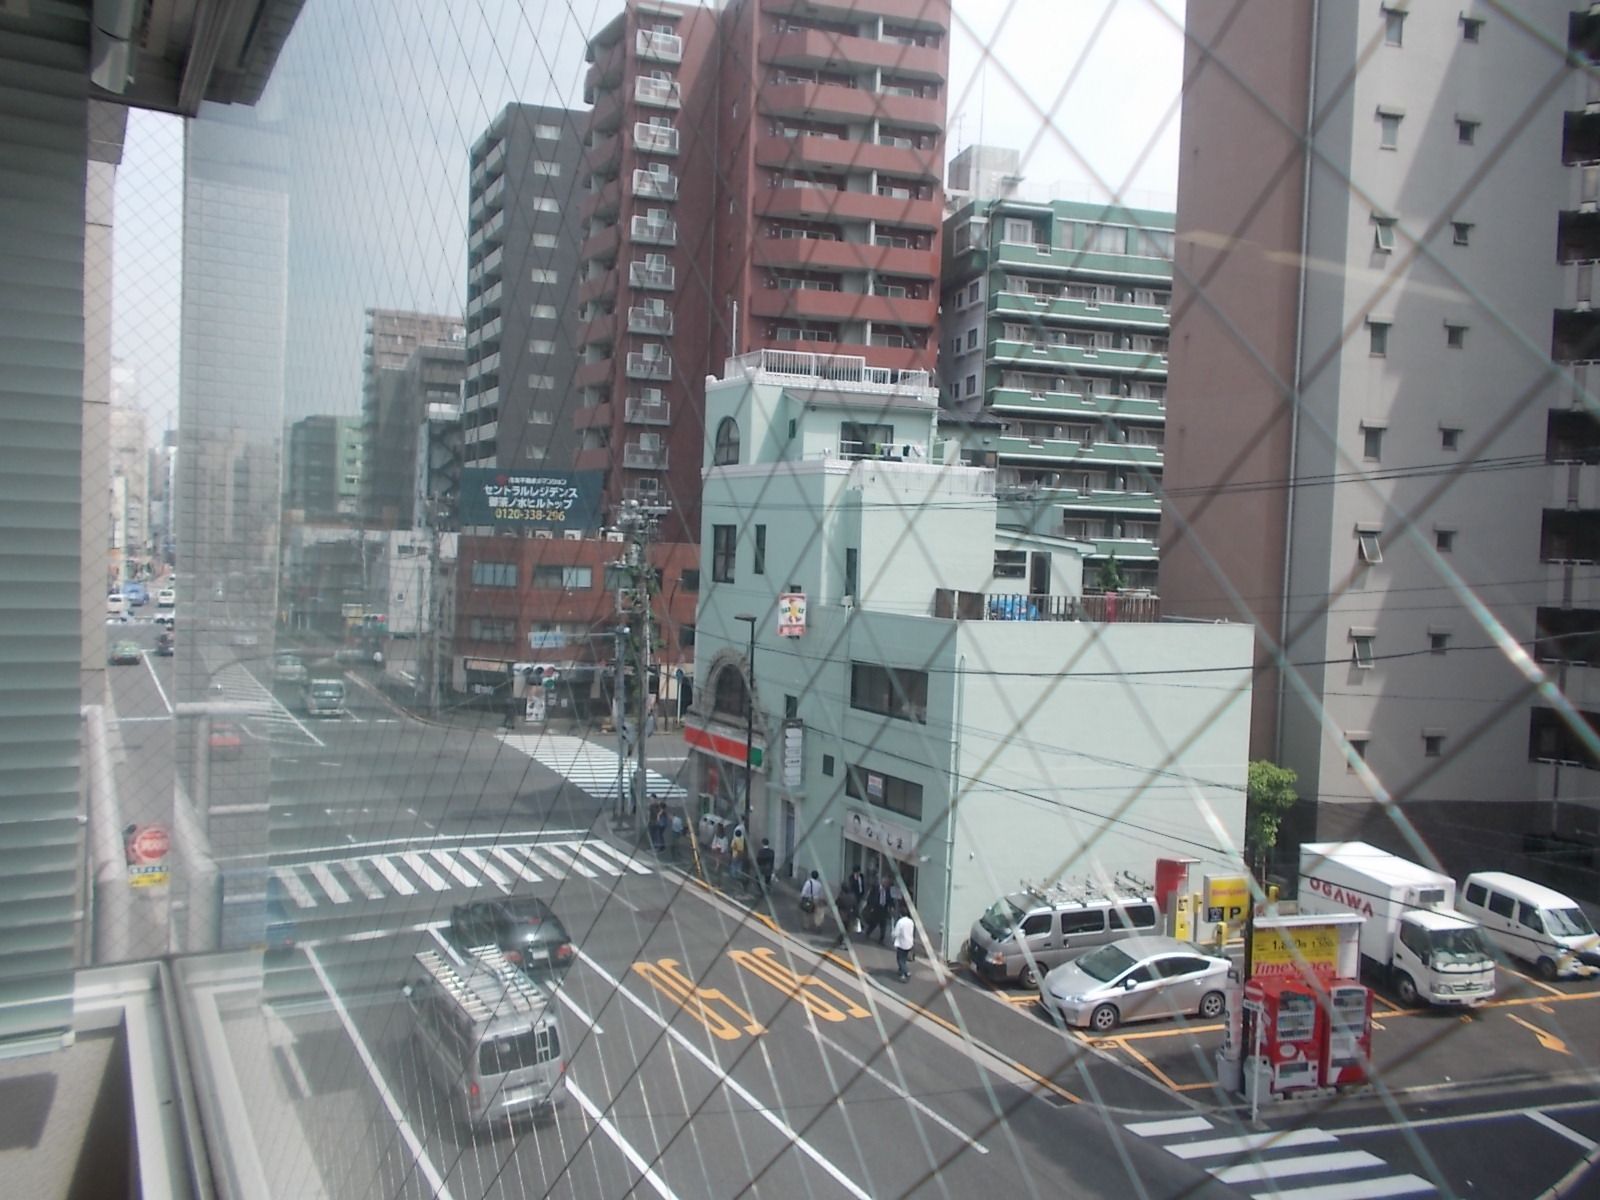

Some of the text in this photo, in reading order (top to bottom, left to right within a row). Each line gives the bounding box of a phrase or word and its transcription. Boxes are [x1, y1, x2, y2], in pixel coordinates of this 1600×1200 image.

[484, 485, 579, 498] セントラルレジデンス
[495, 508, 566, 521] 0120-338-296
[1310, 877, 1374, 917] OGAWA
[1230, 906, 1242, 919] P
[1255, 960, 1334, 976] TimeSace
